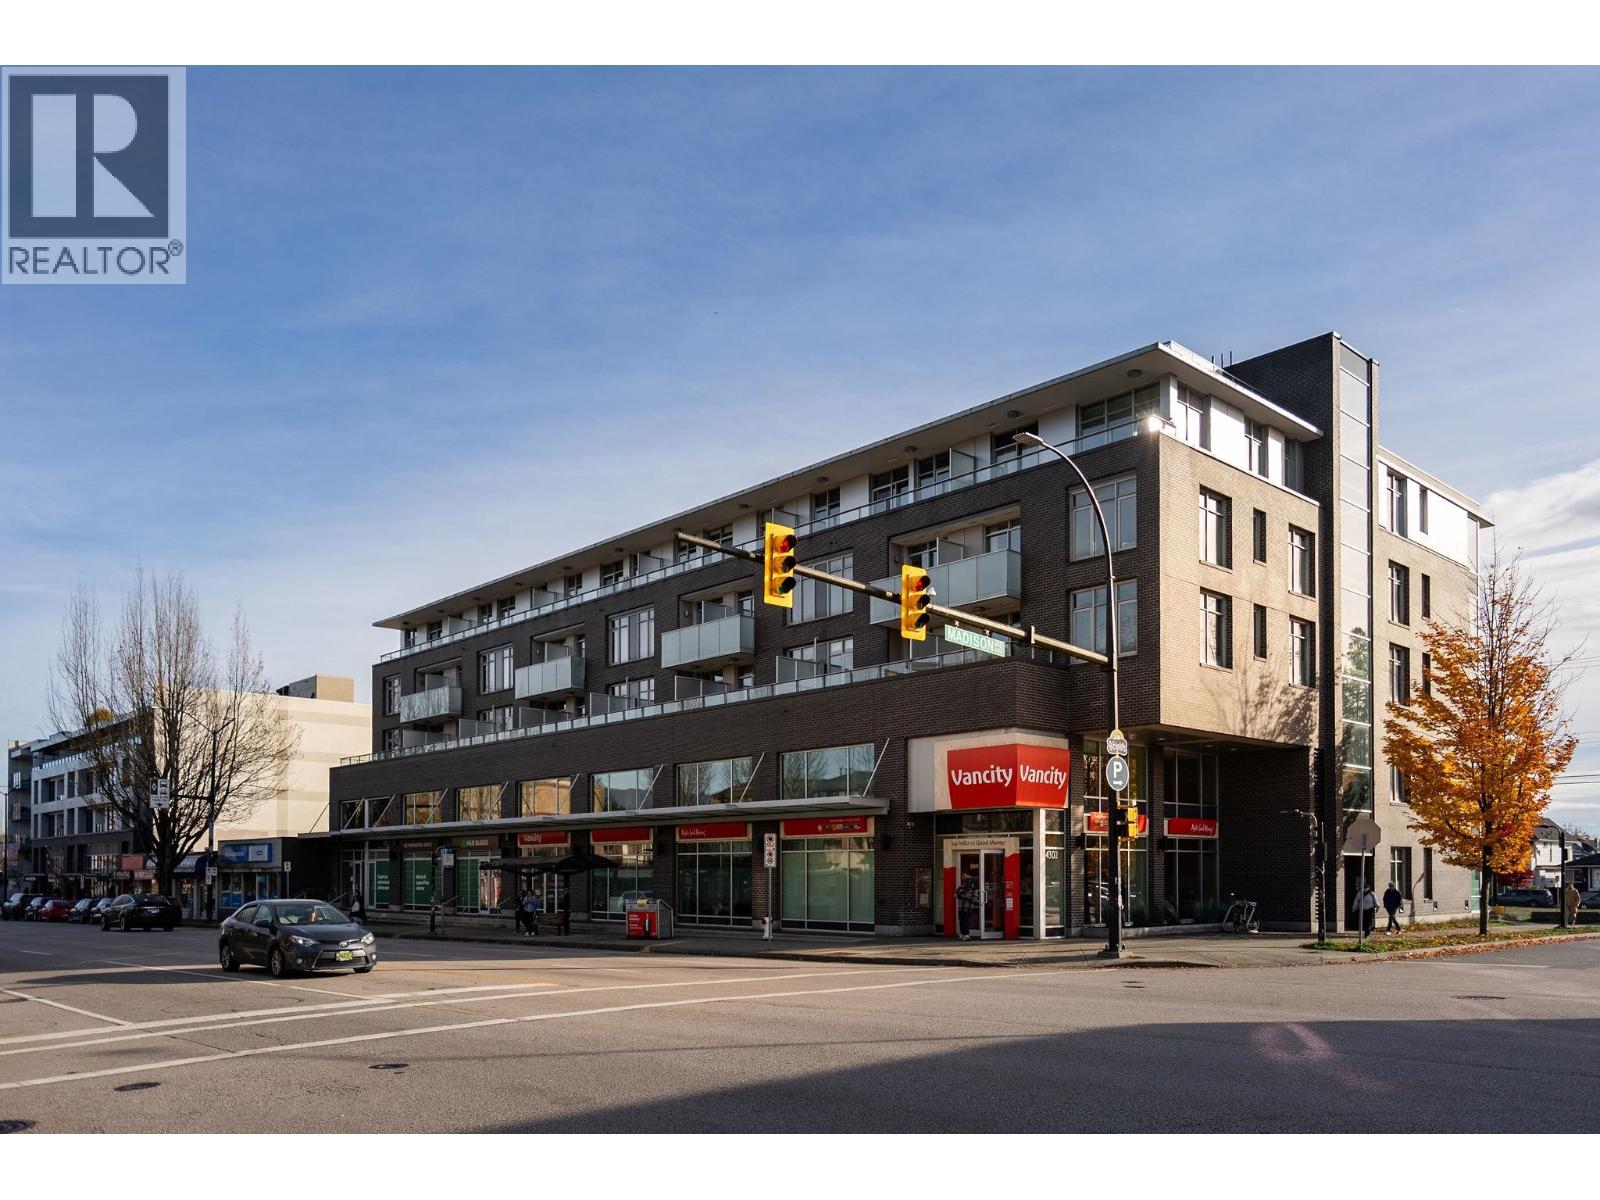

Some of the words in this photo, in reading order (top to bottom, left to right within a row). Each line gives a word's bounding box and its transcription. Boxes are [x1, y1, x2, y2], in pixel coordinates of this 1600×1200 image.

[947, 627, 994, 651] MADISON
[951, 764, 1013, 787] Vancity
[1019, 764, 1067, 789] Vancity
[1113, 761, 1123, 778] P
[523, 833, 541, 843] Vancity
